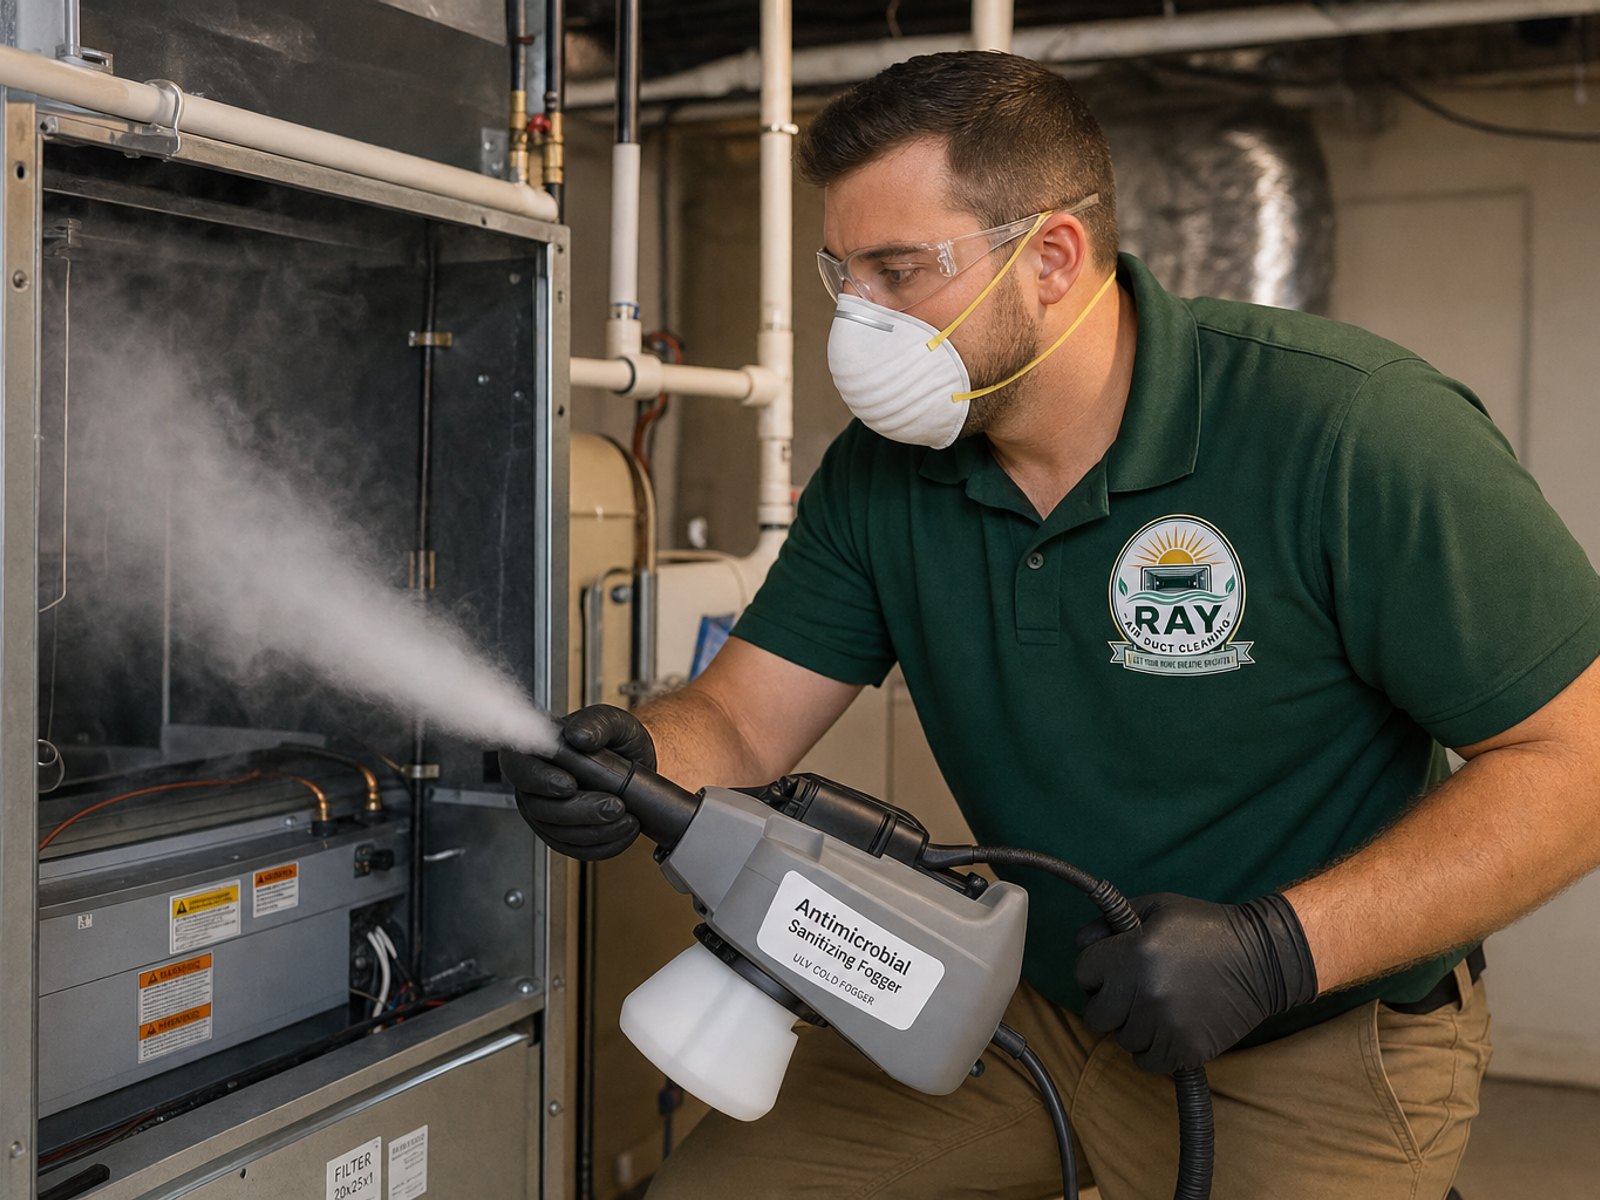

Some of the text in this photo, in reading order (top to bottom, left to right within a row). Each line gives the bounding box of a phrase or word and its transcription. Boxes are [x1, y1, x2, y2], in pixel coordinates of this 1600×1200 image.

[1135, 605, 1223, 635] RAY
[1143, 637, 1174, 653] DUCT
[1178, 619, 1231, 653] CLEANING
[794, 898, 912, 976] Antimicrobial
[788, 918, 902, 994] Sanitizing Fogger
[792, 953, 875, 1006] ULV COLD FOGGER
[334, 1151, 371, 1182] FILTER
[333, 1172, 373, 1200] 20x25x1
